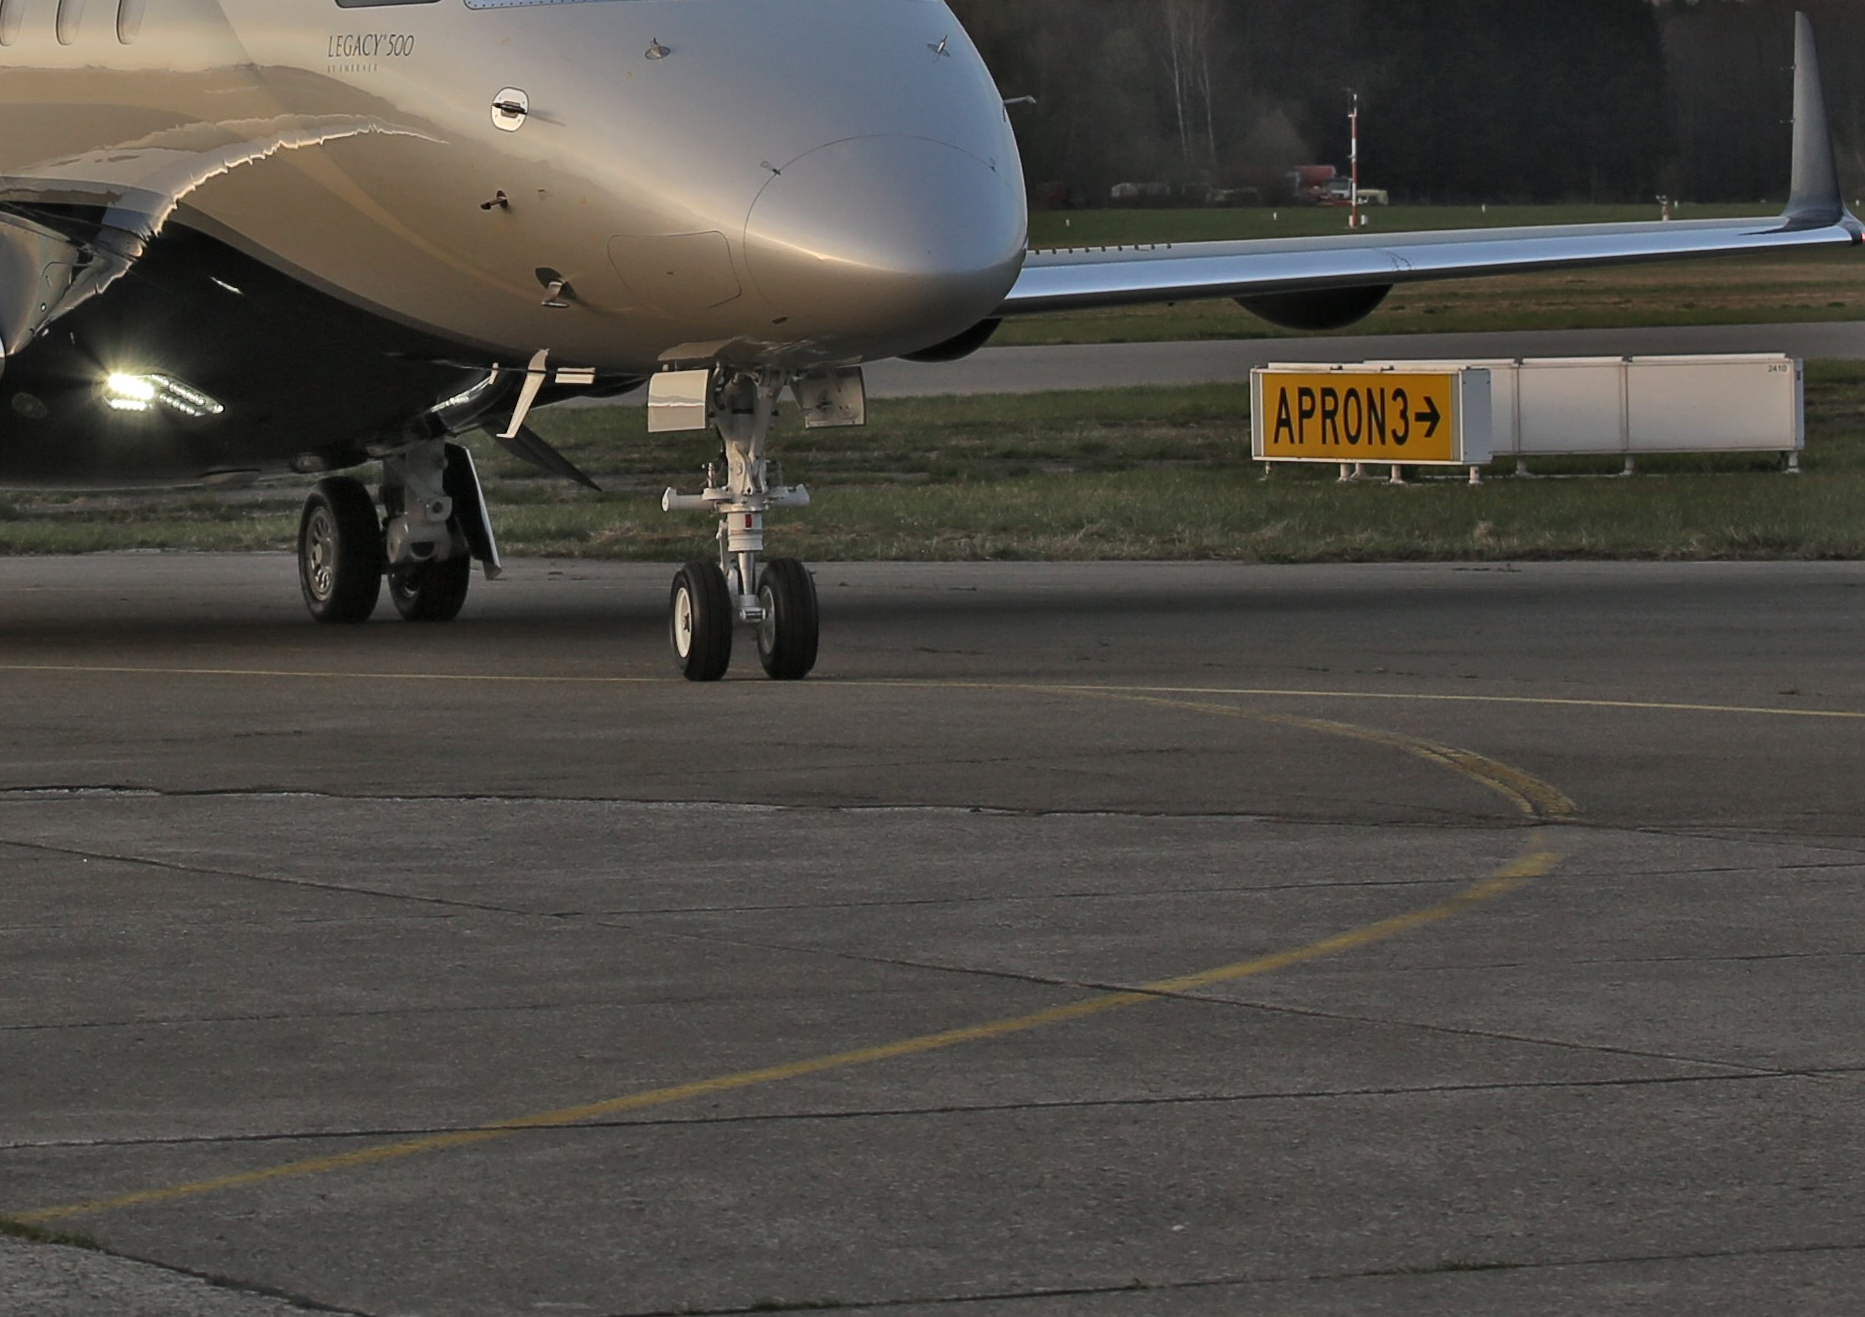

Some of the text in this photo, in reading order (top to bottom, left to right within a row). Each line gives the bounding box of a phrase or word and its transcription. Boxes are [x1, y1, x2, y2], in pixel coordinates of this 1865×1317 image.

[328, 34, 414, 57] LEGACY 500
[1768, 364, 1787, 373] 2410
